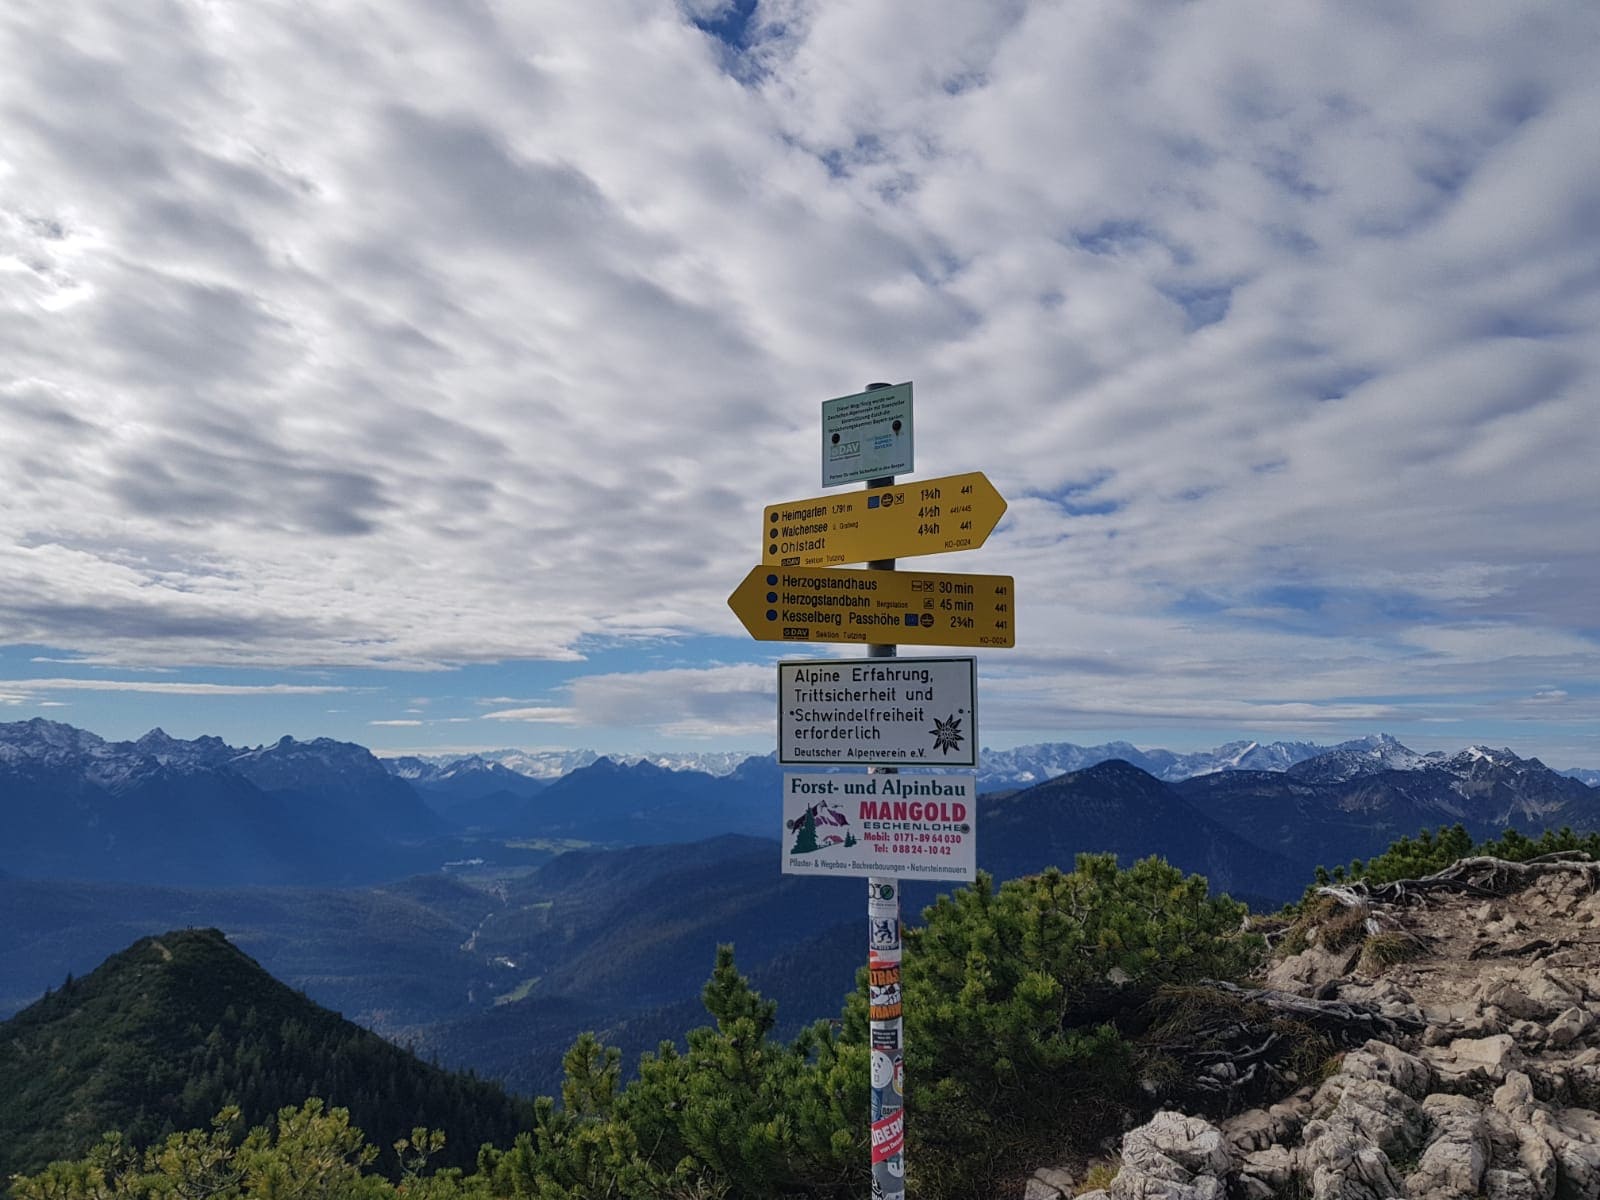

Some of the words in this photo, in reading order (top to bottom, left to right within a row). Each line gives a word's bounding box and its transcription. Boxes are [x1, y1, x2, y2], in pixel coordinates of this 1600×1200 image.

[840, 443, 859, 454] DAV
[782, 505, 827, 522] Heimgarten
[961, 485, 972, 495] 441
[781, 538, 825, 554] Ohlstadt
[960, 521, 972, 531] 441
[782, 522, 828, 538] Walchensee
[782, 575, 877, 590] Herzogstandhaus
[939, 581, 952, 593] 30
[954, 581, 974, 594] min
[995, 586, 1006, 596] 441
[782, 592, 870, 608] Herzogstandbahn
[940, 599, 952, 610] 45
[954, 599, 974, 612] min
[995, 603, 1006, 613] 441
[782, 610, 841, 626] Kesselberg
[849, 612, 900, 626] Passhöhe
[995, 620, 1007, 630] 441
[816, 631, 839, 639] Sektion
[843, 631, 866, 640] Tutzing
[795, 669, 840, 685] Alpine
[853, 668, 933, 683] Erfahrung,
[795, 688, 896, 702] Trittsicherheit
[906, 688, 933, 701] und
[795, 708, 924, 721] Schwindelfreiheit
[795, 726, 880, 739] erforderlich
[795, 748, 841, 757] Deutscher
[848, 748, 906, 758] Alpenverein
[911, 749, 926, 758] e.V.
[791, 778, 838, 794] Forst-
[845, 779, 876, 795] und
[882, 779, 965, 798] Alpinbau
[859, 801, 966, 822] MANGOLD
[864, 822, 961, 831] ESCHENLOHE
[864, 833, 890, 841] Mobil:
[874, 845, 888, 853] Tel:
[790, 858, 813, 867] Pflaster-
[815, 859, 819, 867] &
[821, 860, 847, 870] Wegebau
[852, 861, 905, 871] Bachverbauungen
[911, 863, 967, 874] Natursteinmauern
